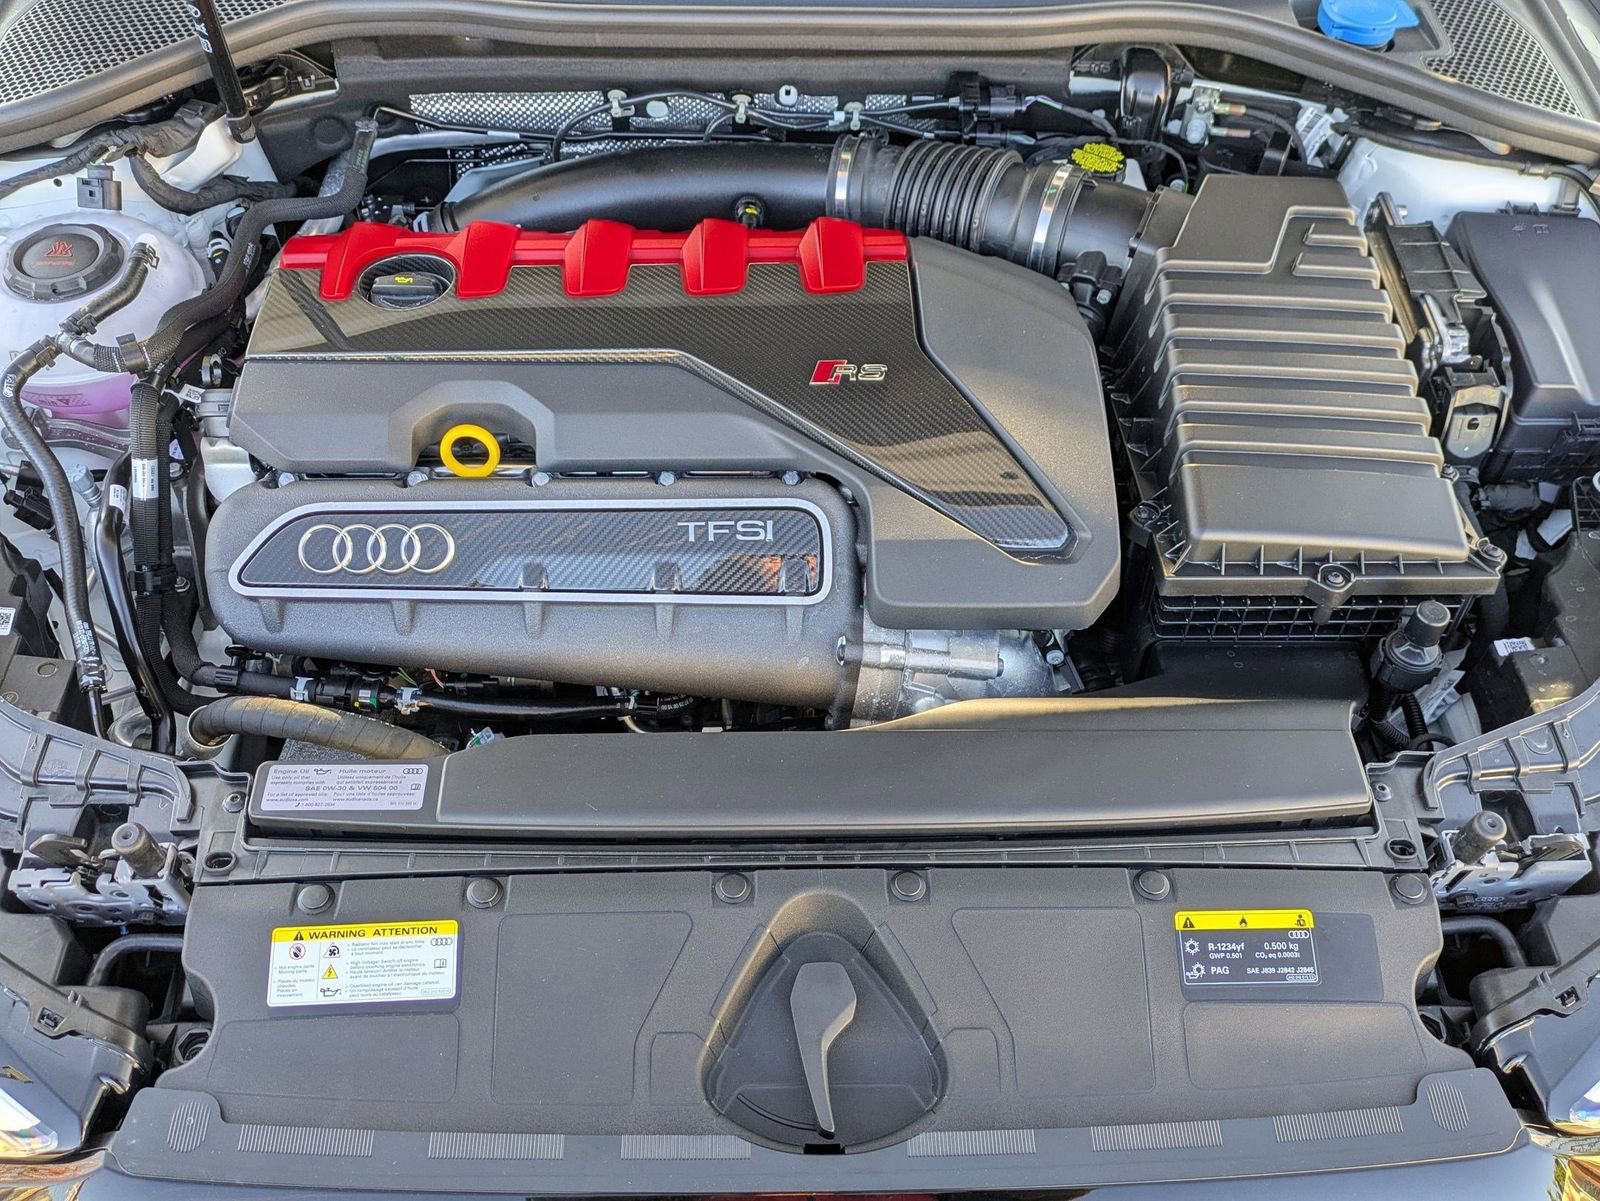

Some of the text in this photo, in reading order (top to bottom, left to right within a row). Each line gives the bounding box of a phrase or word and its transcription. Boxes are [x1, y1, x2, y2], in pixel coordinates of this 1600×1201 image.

[828, 364, 888, 381] RS
[676, 520, 774, 542] TFSI
[308, 926, 438, 940] WARNING ATTENTION
[1208, 942, 1300, 952] R-1234yf 0.500 kg
[1210, 966, 1230, 975] PAG
